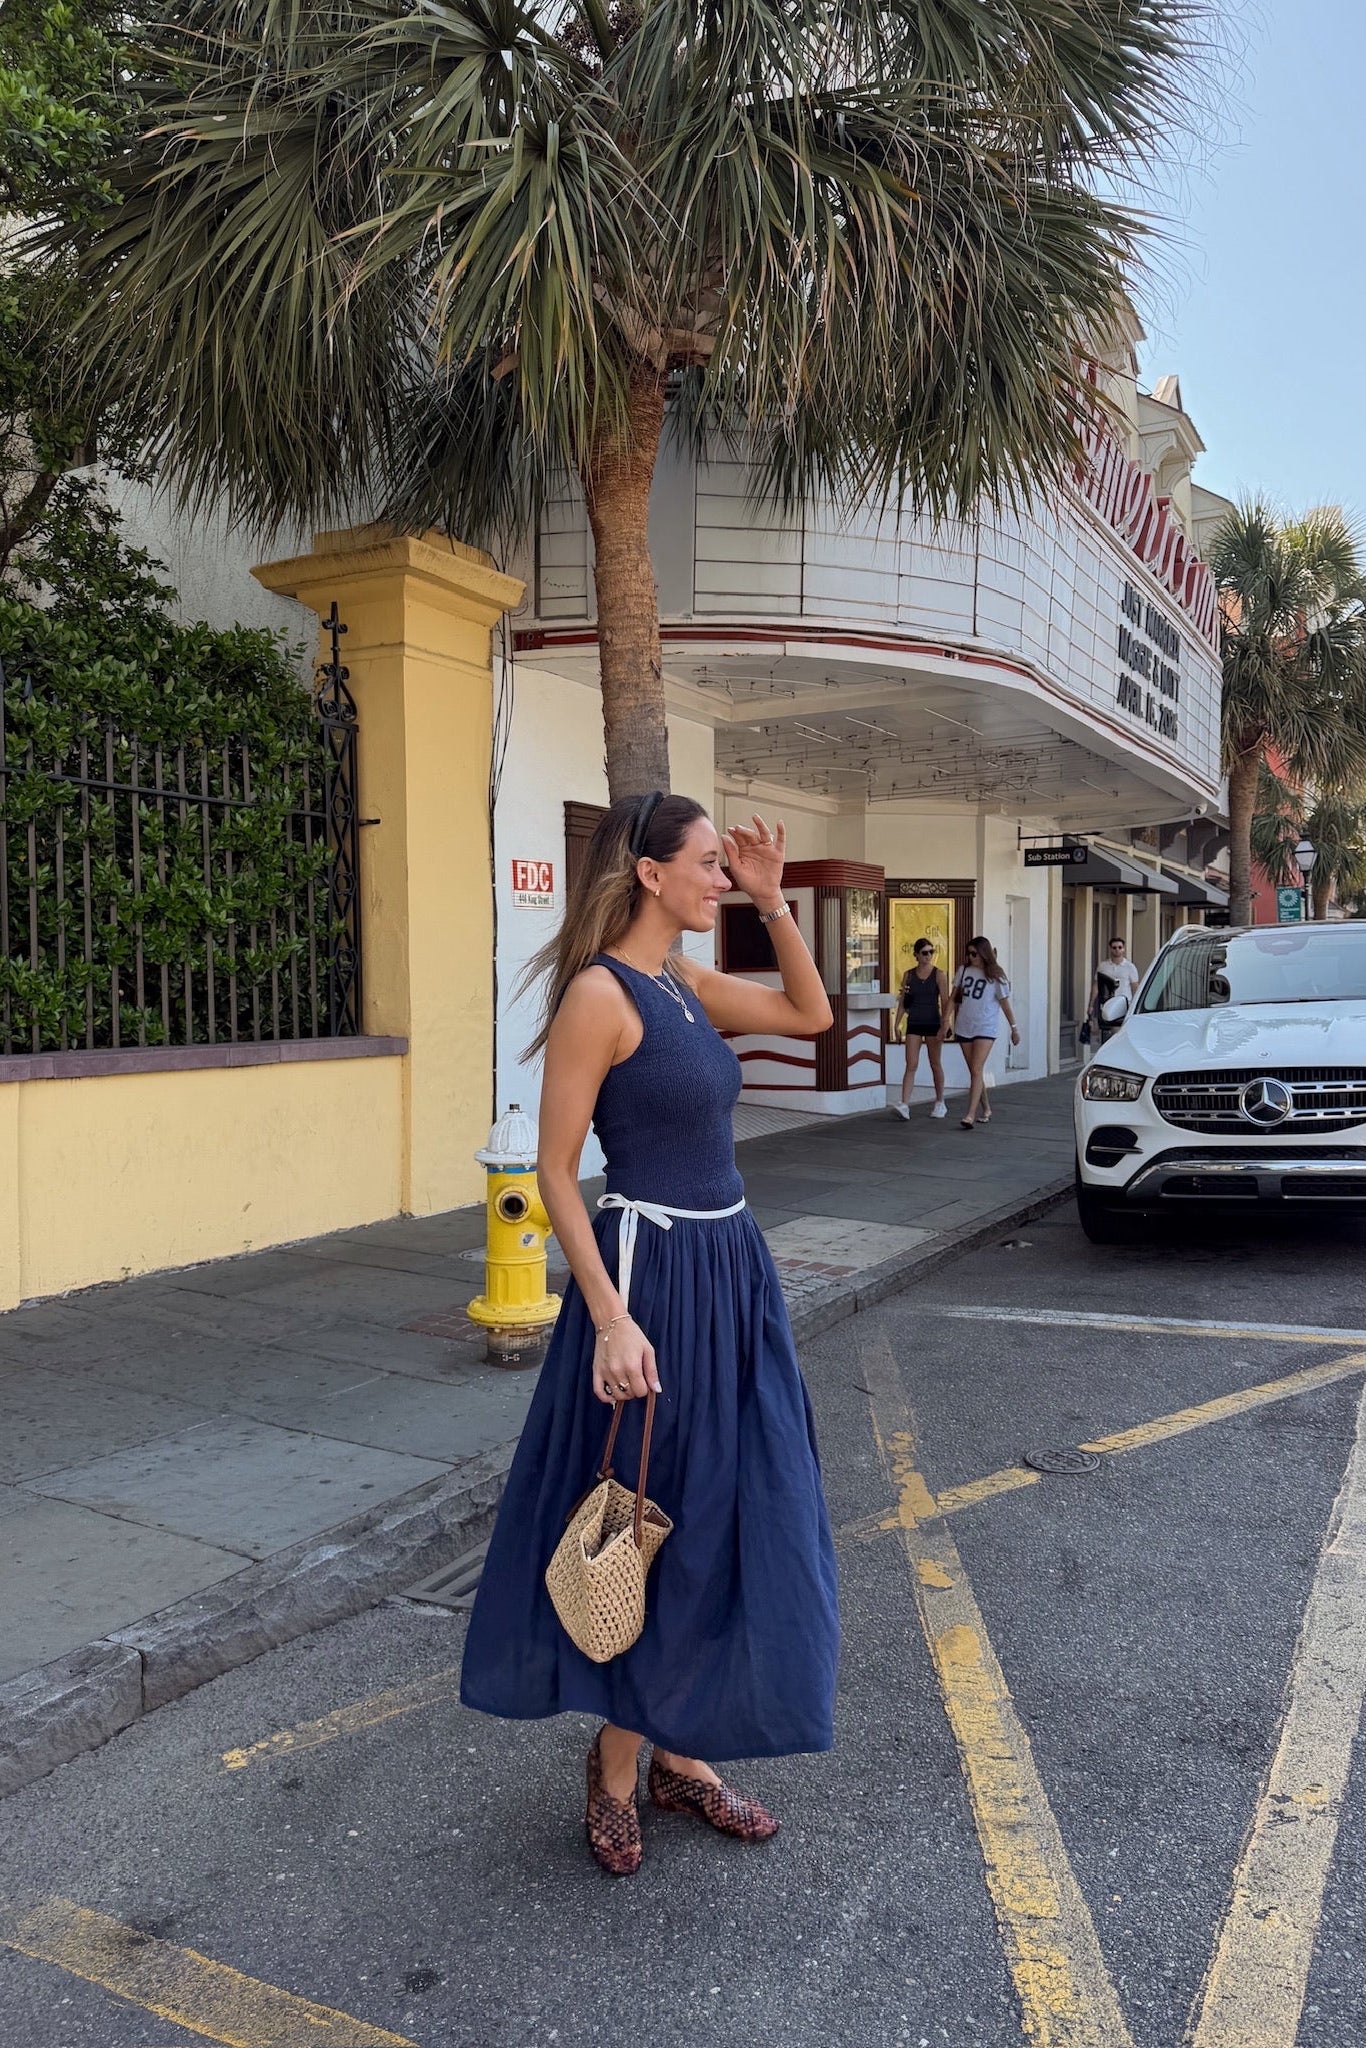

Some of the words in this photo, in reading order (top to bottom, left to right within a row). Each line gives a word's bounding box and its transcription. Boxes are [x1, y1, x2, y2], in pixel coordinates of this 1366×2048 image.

[1121, 580, 1145, 629] JUST
[1118, 623, 1153, 681] MAGGIE
[1152, 654, 1160, 688] &
[1160, 661, 1181, 703] MATT
[1116, 671, 1144, 718] APRIL
[516, 861, 550, 891] FDC
[1027, 853, 1043, 862] Sub
[1043, 852, 1071, 861] Station
[963, 975, 988, 1000] 28
